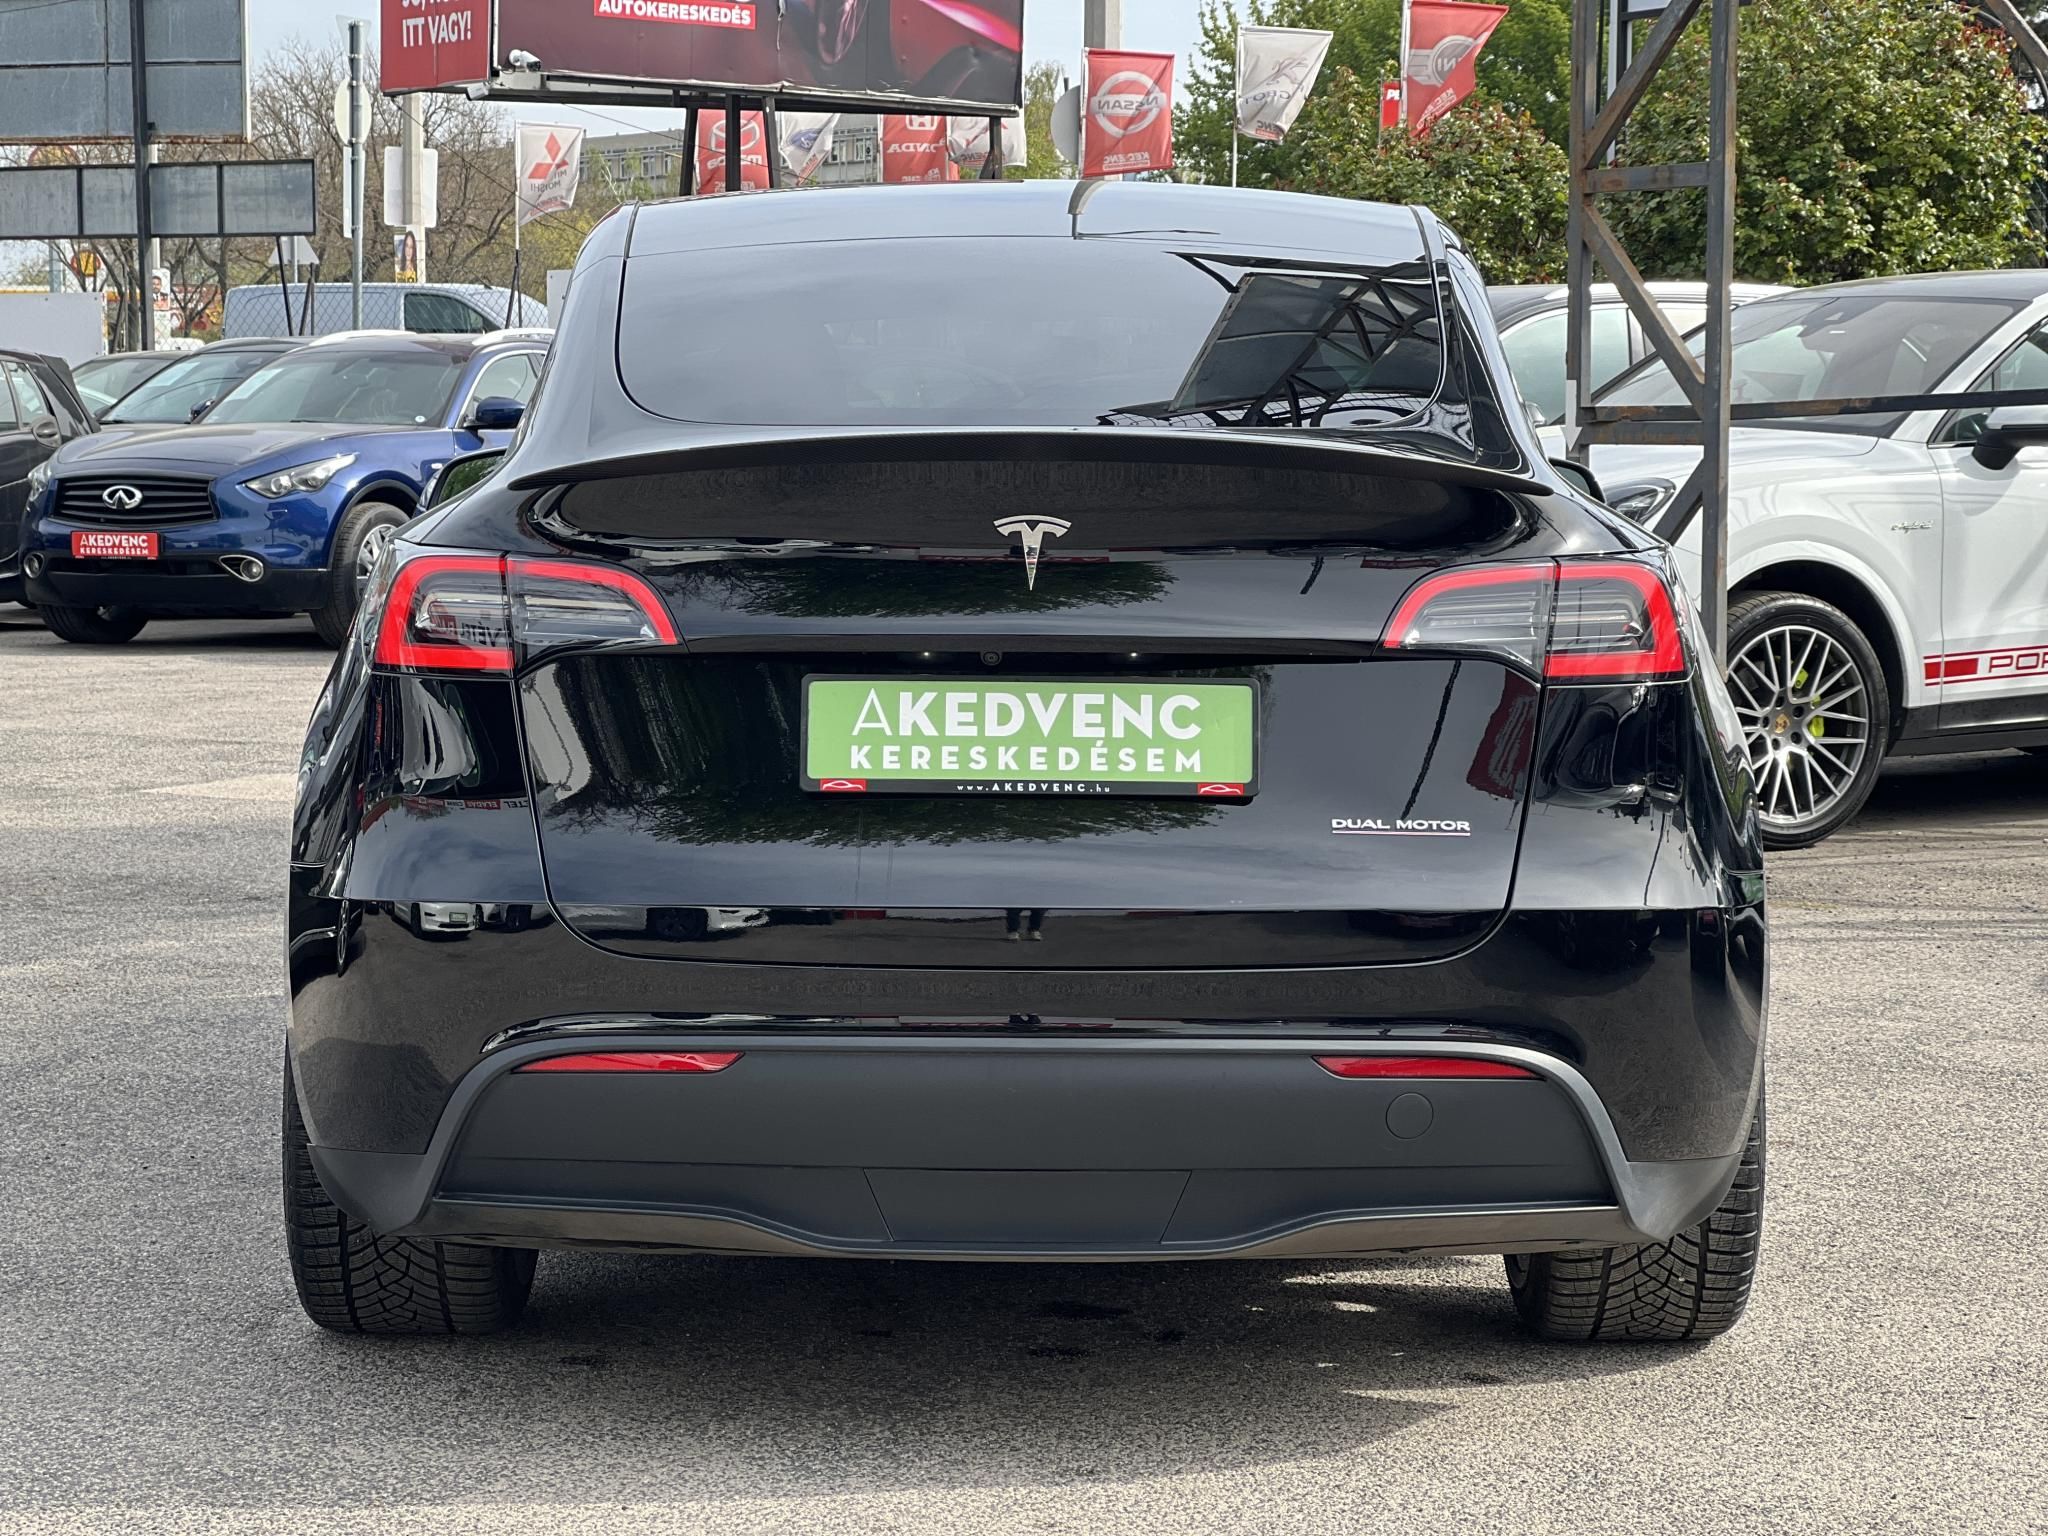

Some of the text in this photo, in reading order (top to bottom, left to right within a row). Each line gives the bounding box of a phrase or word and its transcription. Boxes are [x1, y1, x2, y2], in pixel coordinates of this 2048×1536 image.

[402, 10, 472, 48] ITT VAGY!
[80, 547, 149, 555] KERESKEDÉSEM
[1988, 651, 2048, 673] PO
[850, 740, 1202, 774] KERESKEDÉSEM
[956, 782, 1111, 794] www.AKEDVENC.hu
[1331, 818, 1471, 831] DUAL MOTOR
